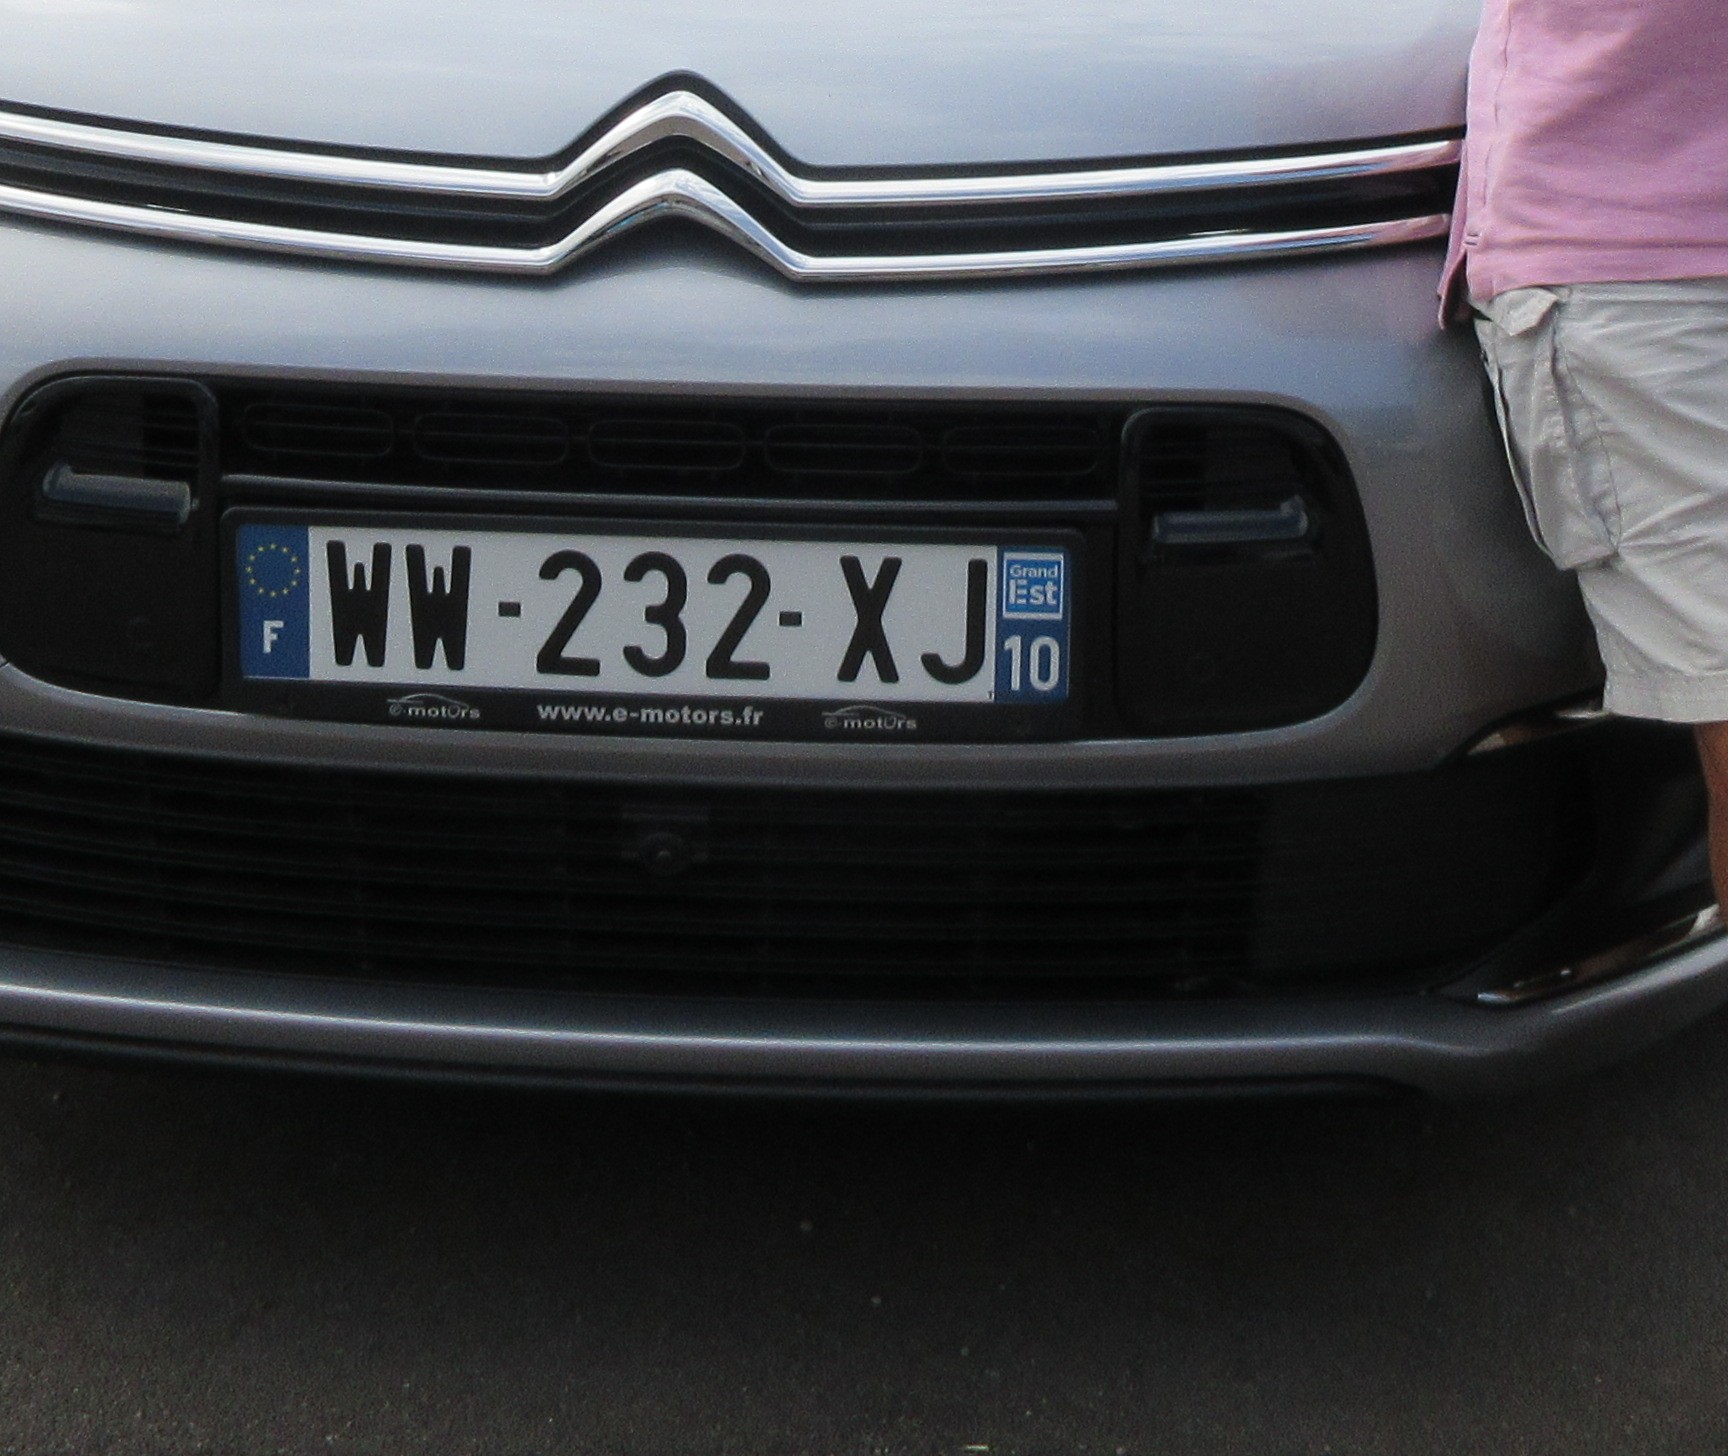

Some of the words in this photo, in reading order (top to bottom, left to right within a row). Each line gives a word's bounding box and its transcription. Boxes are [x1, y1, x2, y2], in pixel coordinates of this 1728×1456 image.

[1009, 564, 1059, 578] Grand
[1008, 578, 1058, 606] Est
[262, 619, 284, 654] F
[1003, 634, 1060, 692] 10
[536, 703, 764, 727] www.e-motors.fr
